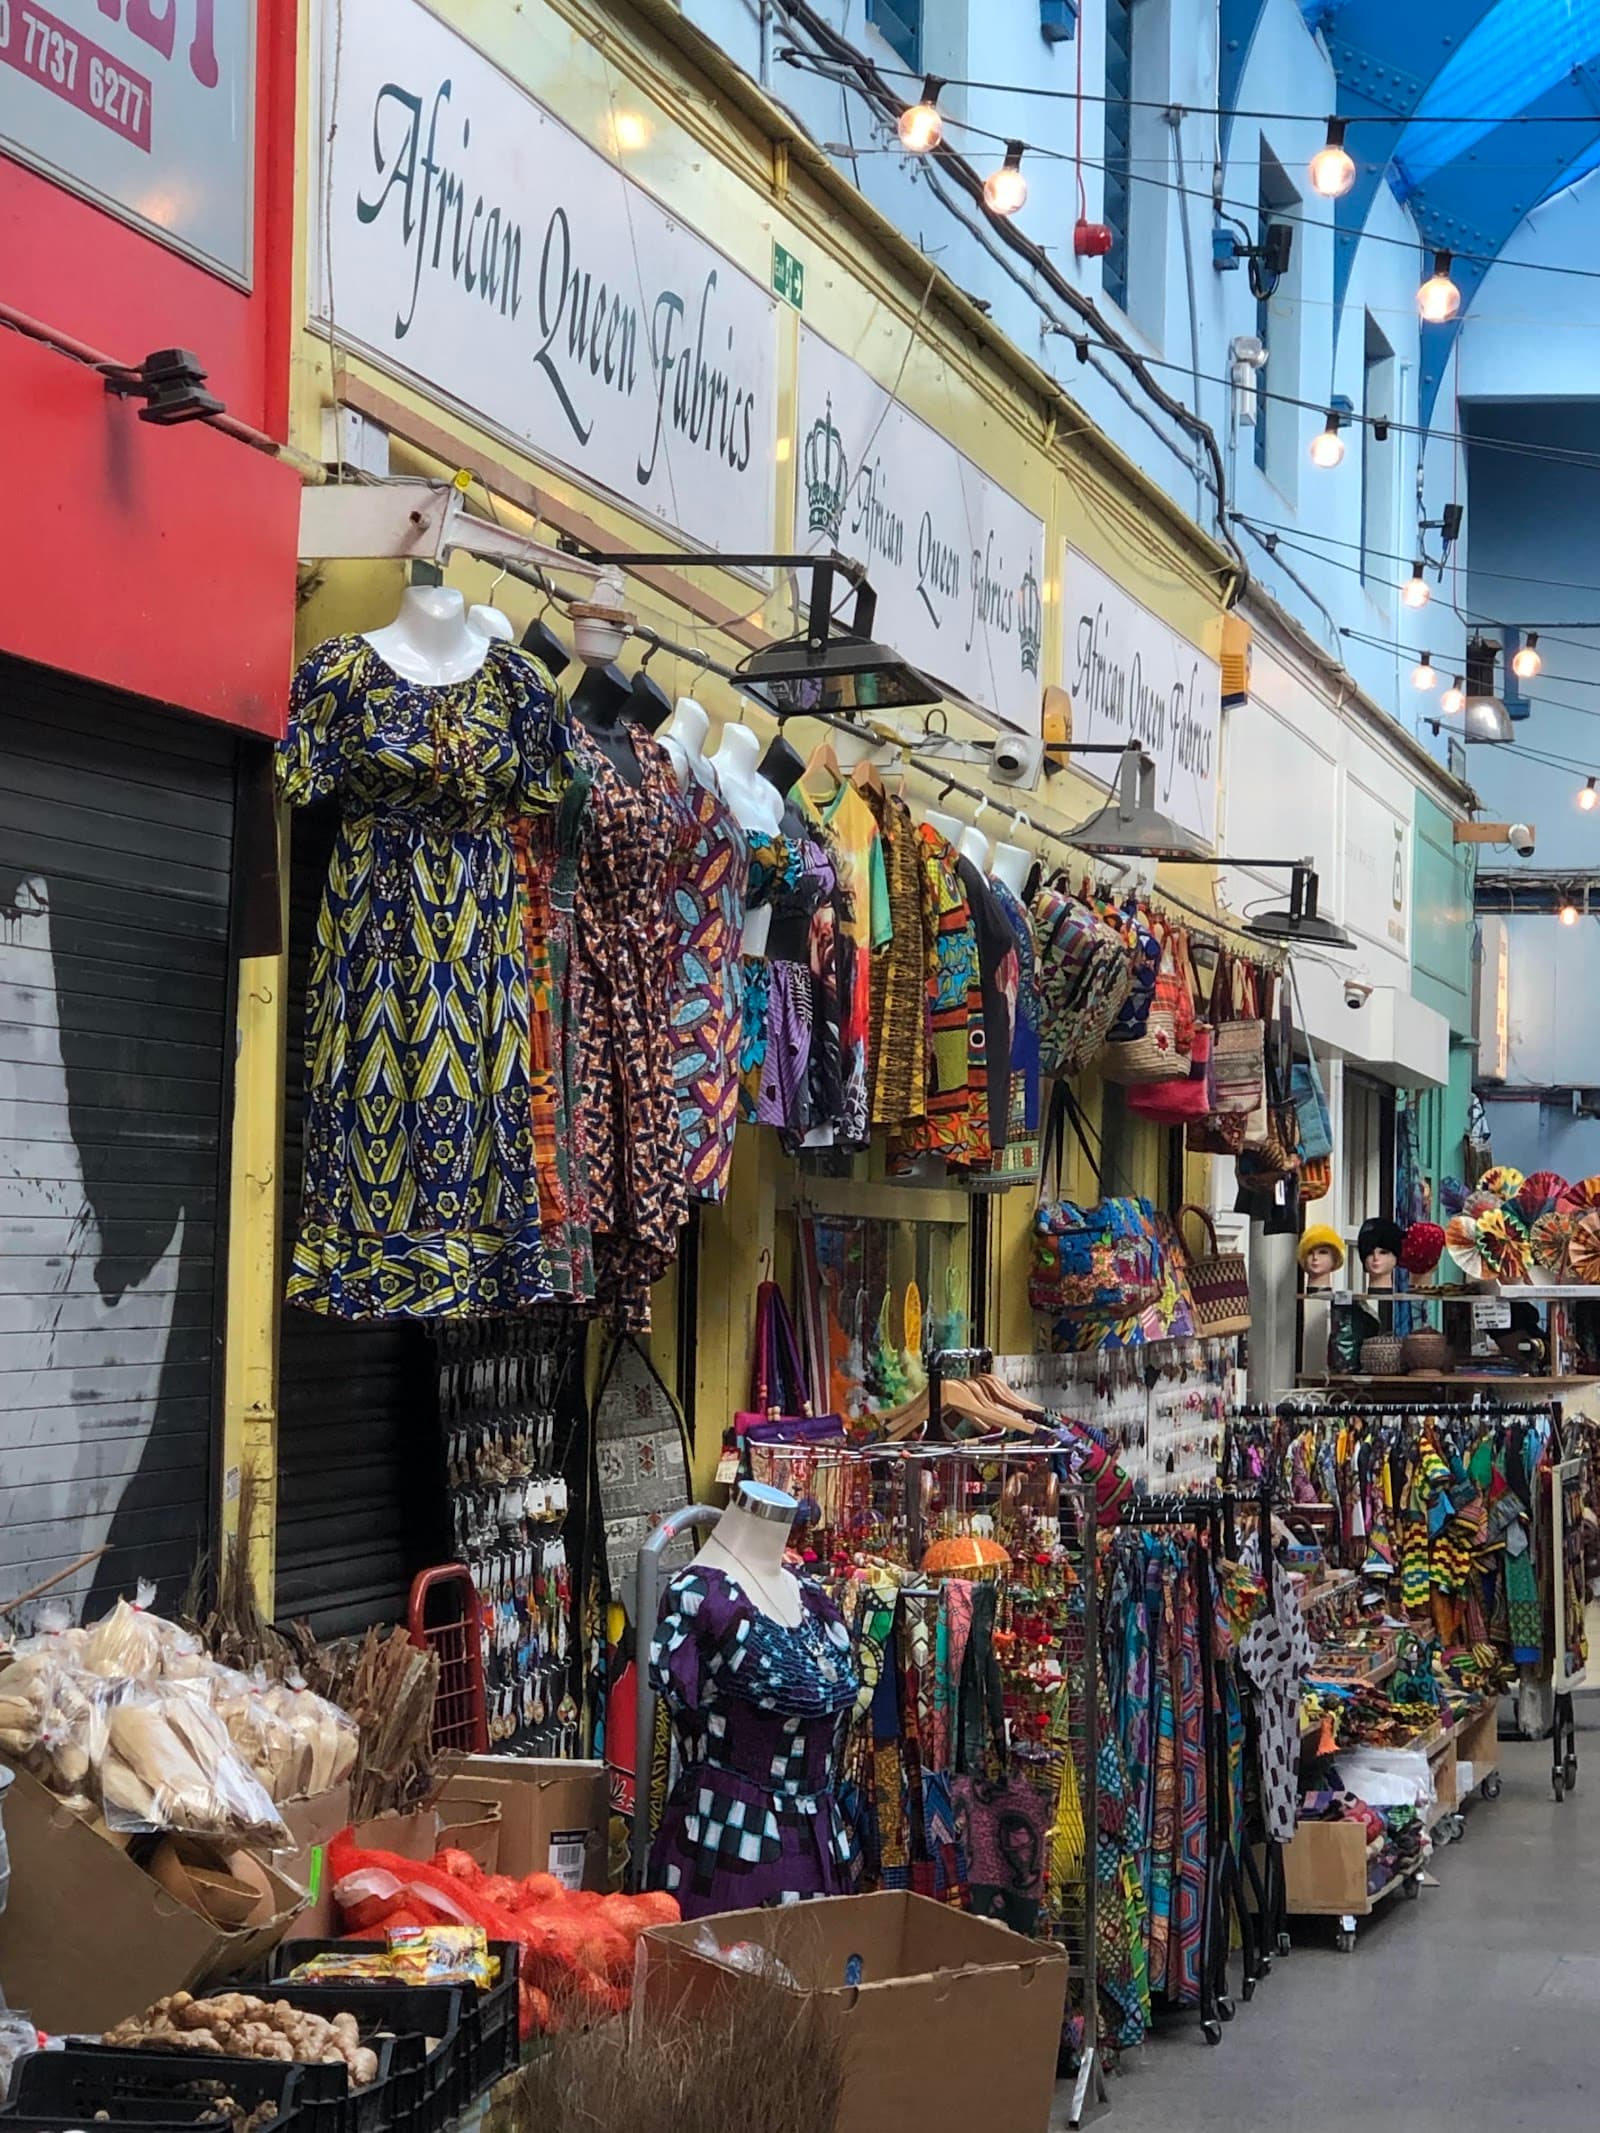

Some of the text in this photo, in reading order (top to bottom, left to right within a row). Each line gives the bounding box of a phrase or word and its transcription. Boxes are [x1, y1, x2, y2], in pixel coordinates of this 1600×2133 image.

[22, 11, 79, 91] 7737
[89, 56, 144, 133] 6277
[357, 79, 755, 485] African Queen Fabrics
[852, 456, 1014, 652] African Queen Fabrics
[1072, 602, 1212, 803] African Queen Fabrics
